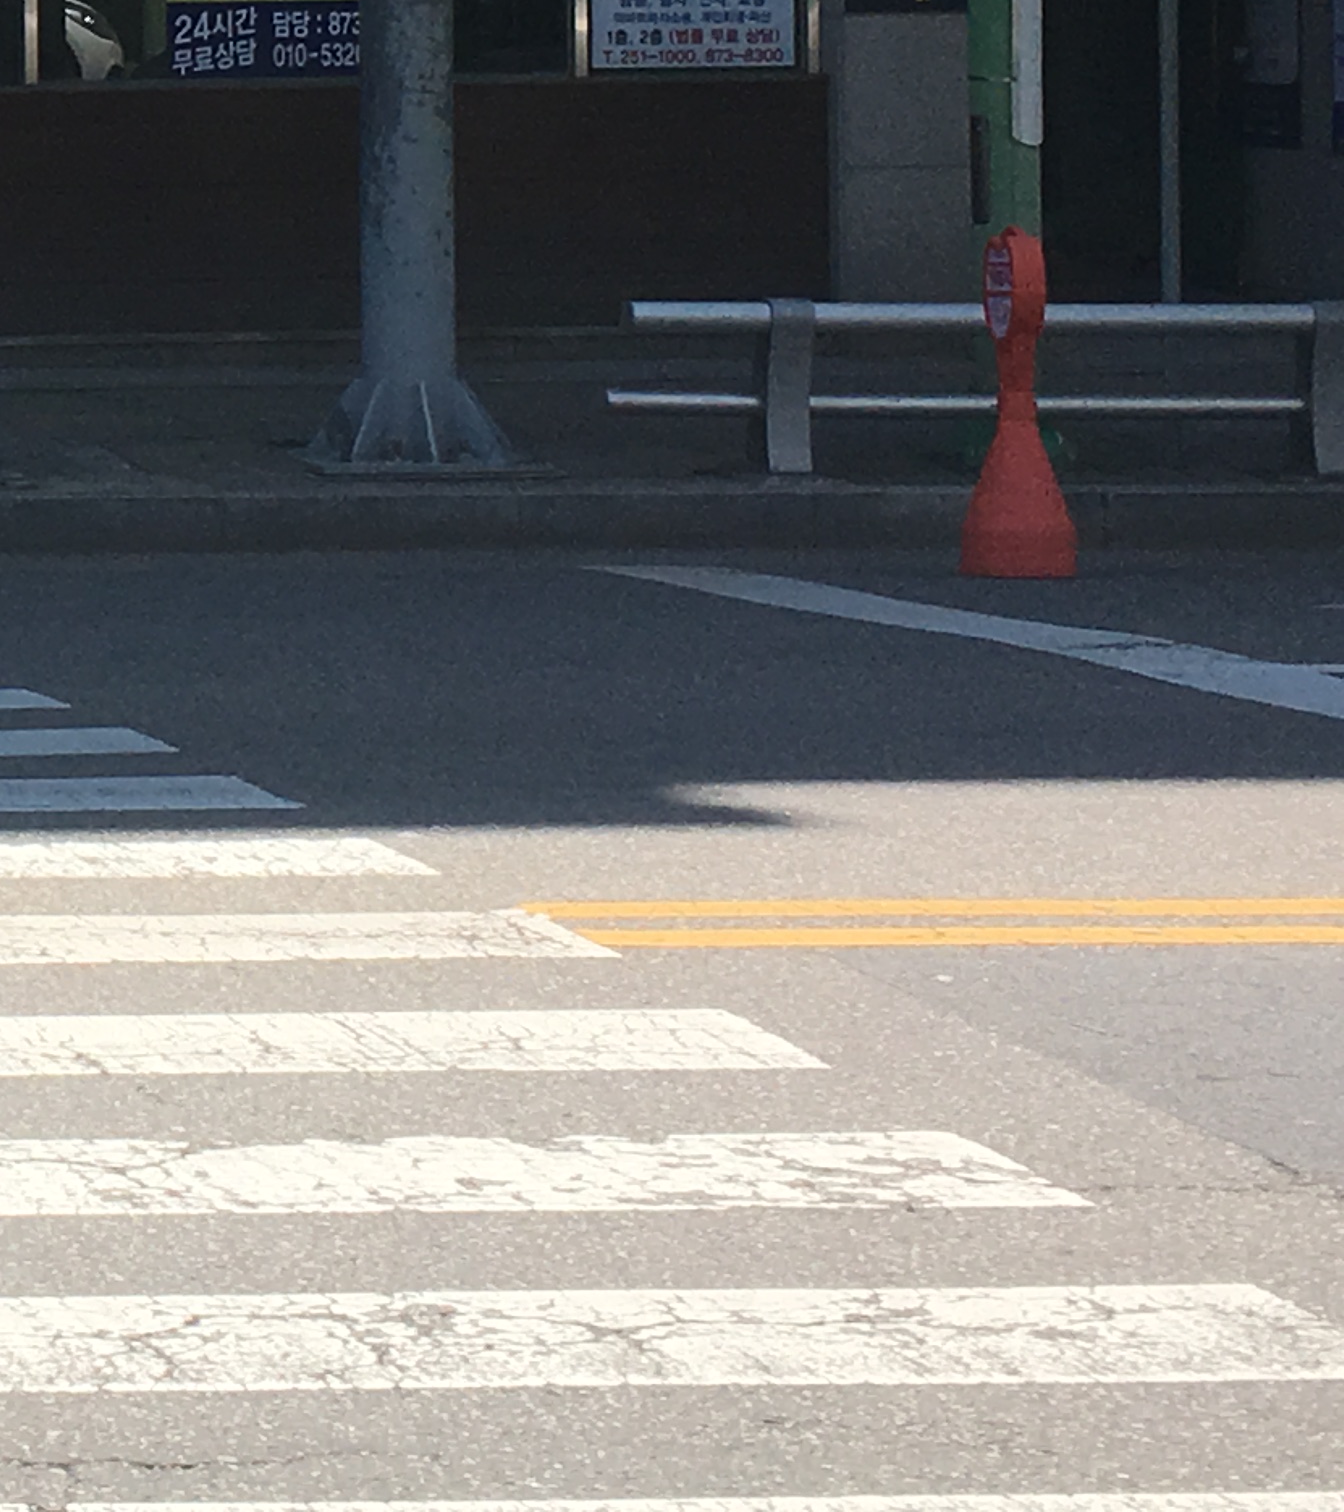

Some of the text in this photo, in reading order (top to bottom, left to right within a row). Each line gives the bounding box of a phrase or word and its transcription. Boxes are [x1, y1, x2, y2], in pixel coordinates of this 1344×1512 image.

[173, 5, 258, 46] 24시간
[172, 37, 360, 76] 무료상담 010-532
